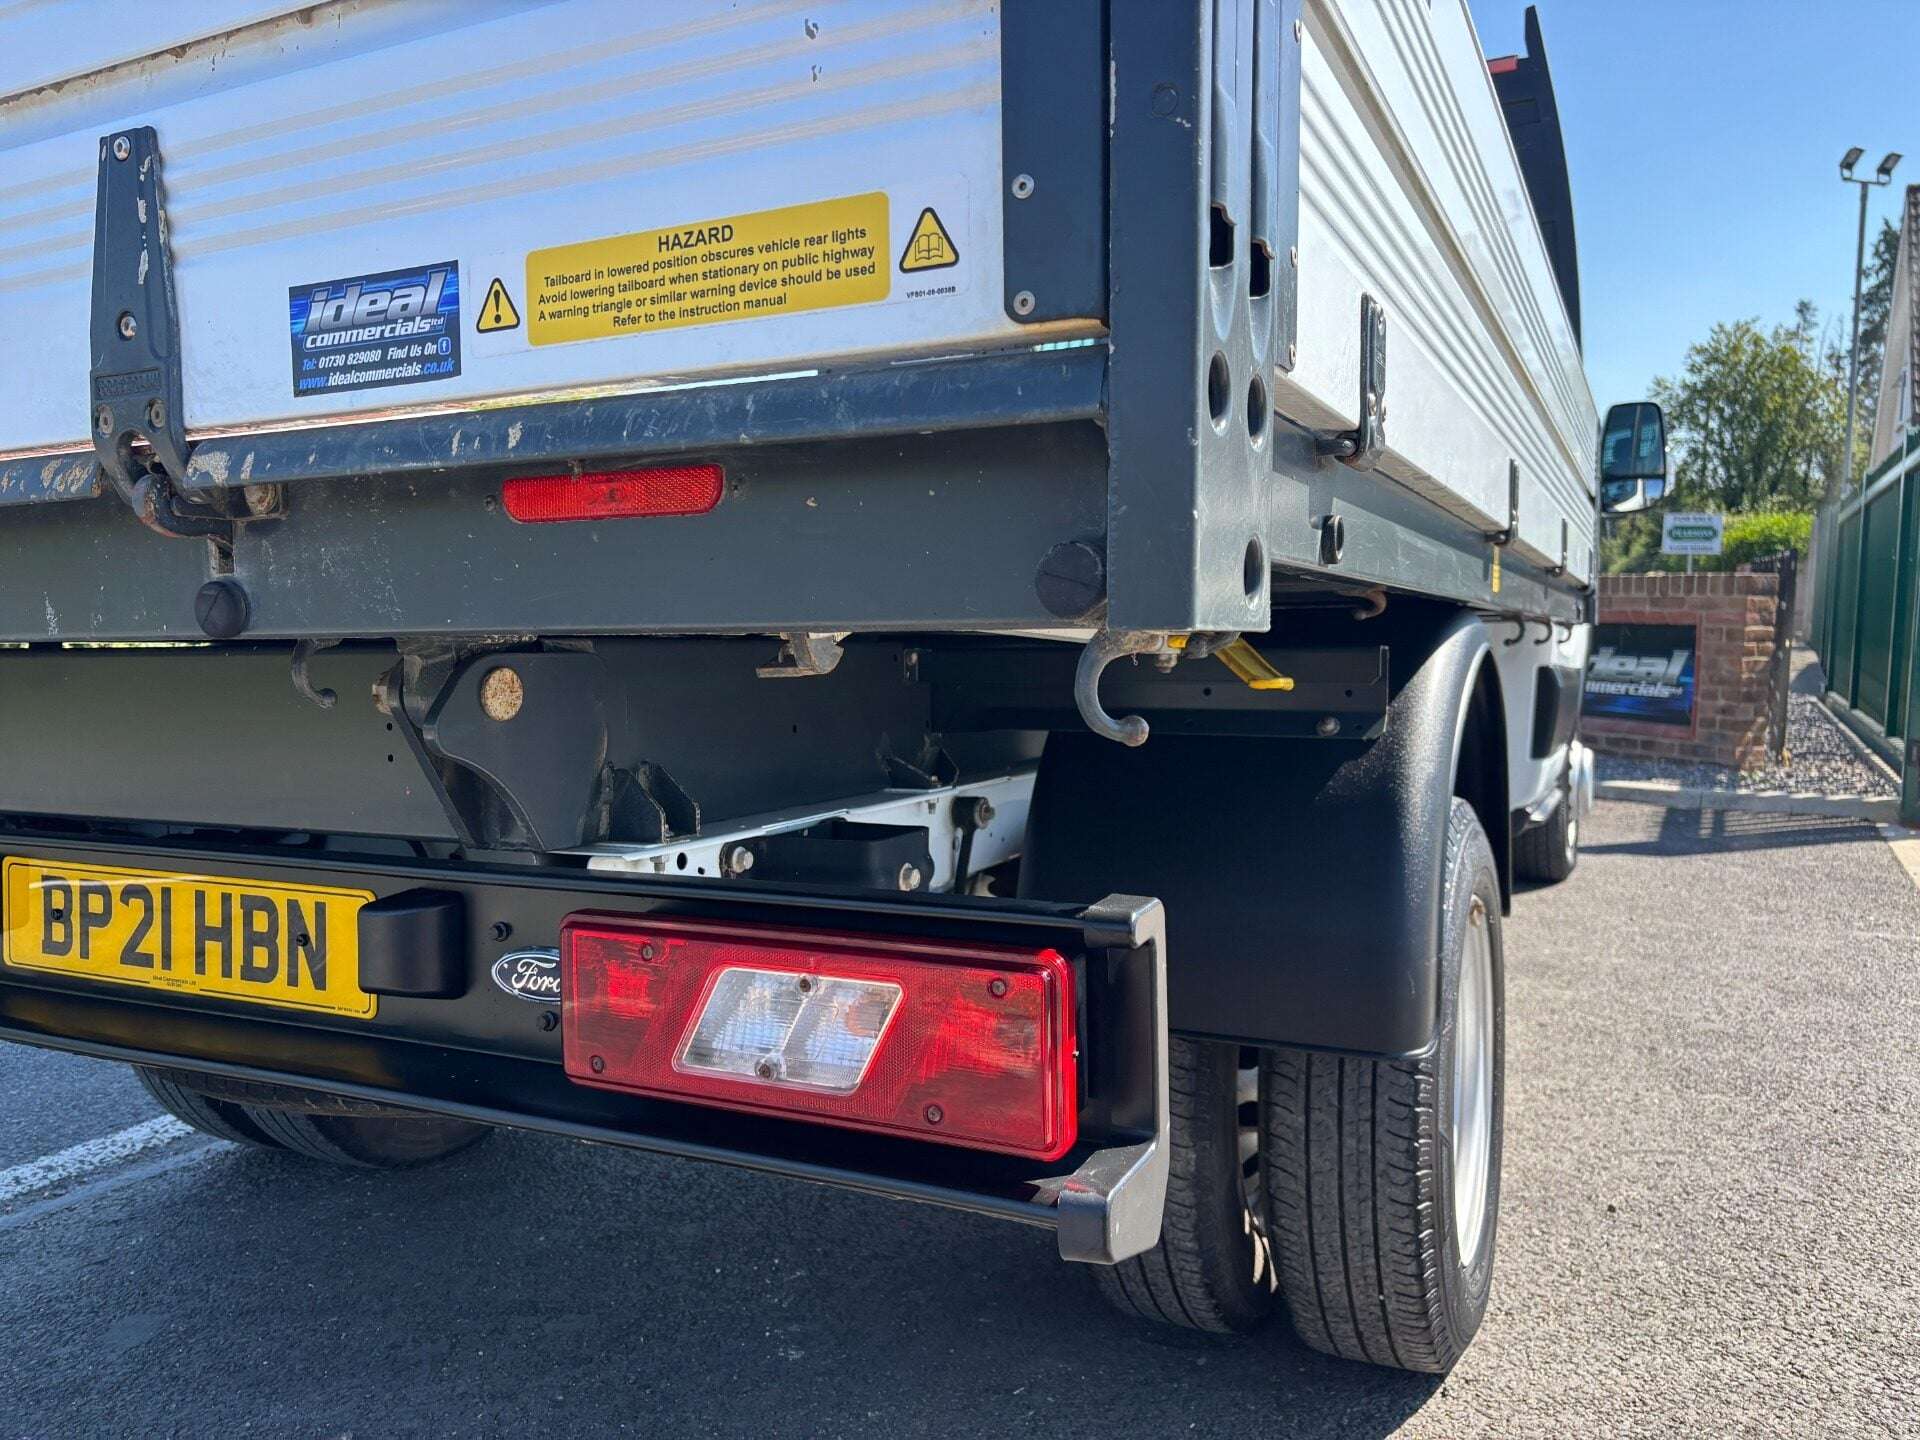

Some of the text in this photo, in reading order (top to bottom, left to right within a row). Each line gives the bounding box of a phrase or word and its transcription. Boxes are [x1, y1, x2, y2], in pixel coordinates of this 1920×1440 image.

[544, 227, 867, 288] Tailboard in lowered position obscures vehicle rear lights
[657, 224, 734, 253] HAZARD
[538, 245, 876, 307] Avoid lowering tailboard when stationary on public highway
[538, 262, 876, 323] A warning triangle or similar warning device should be used
[304, 270, 447, 333] ideal
[612, 292, 787, 328] Refer to the instruction manual
[305, 316, 431, 348] commercials
[319, 354, 346, 369] 01730
[347, 349, 382, 365] 829080
[387, 345, 409, 360] Find
[409, 344, 423, 357] Us
[424, 342, 437, 355] On
[299, 357, 455, 390] www.idealcommercials.co.uk
[41, 874, 327, 992] BP21 HBN
